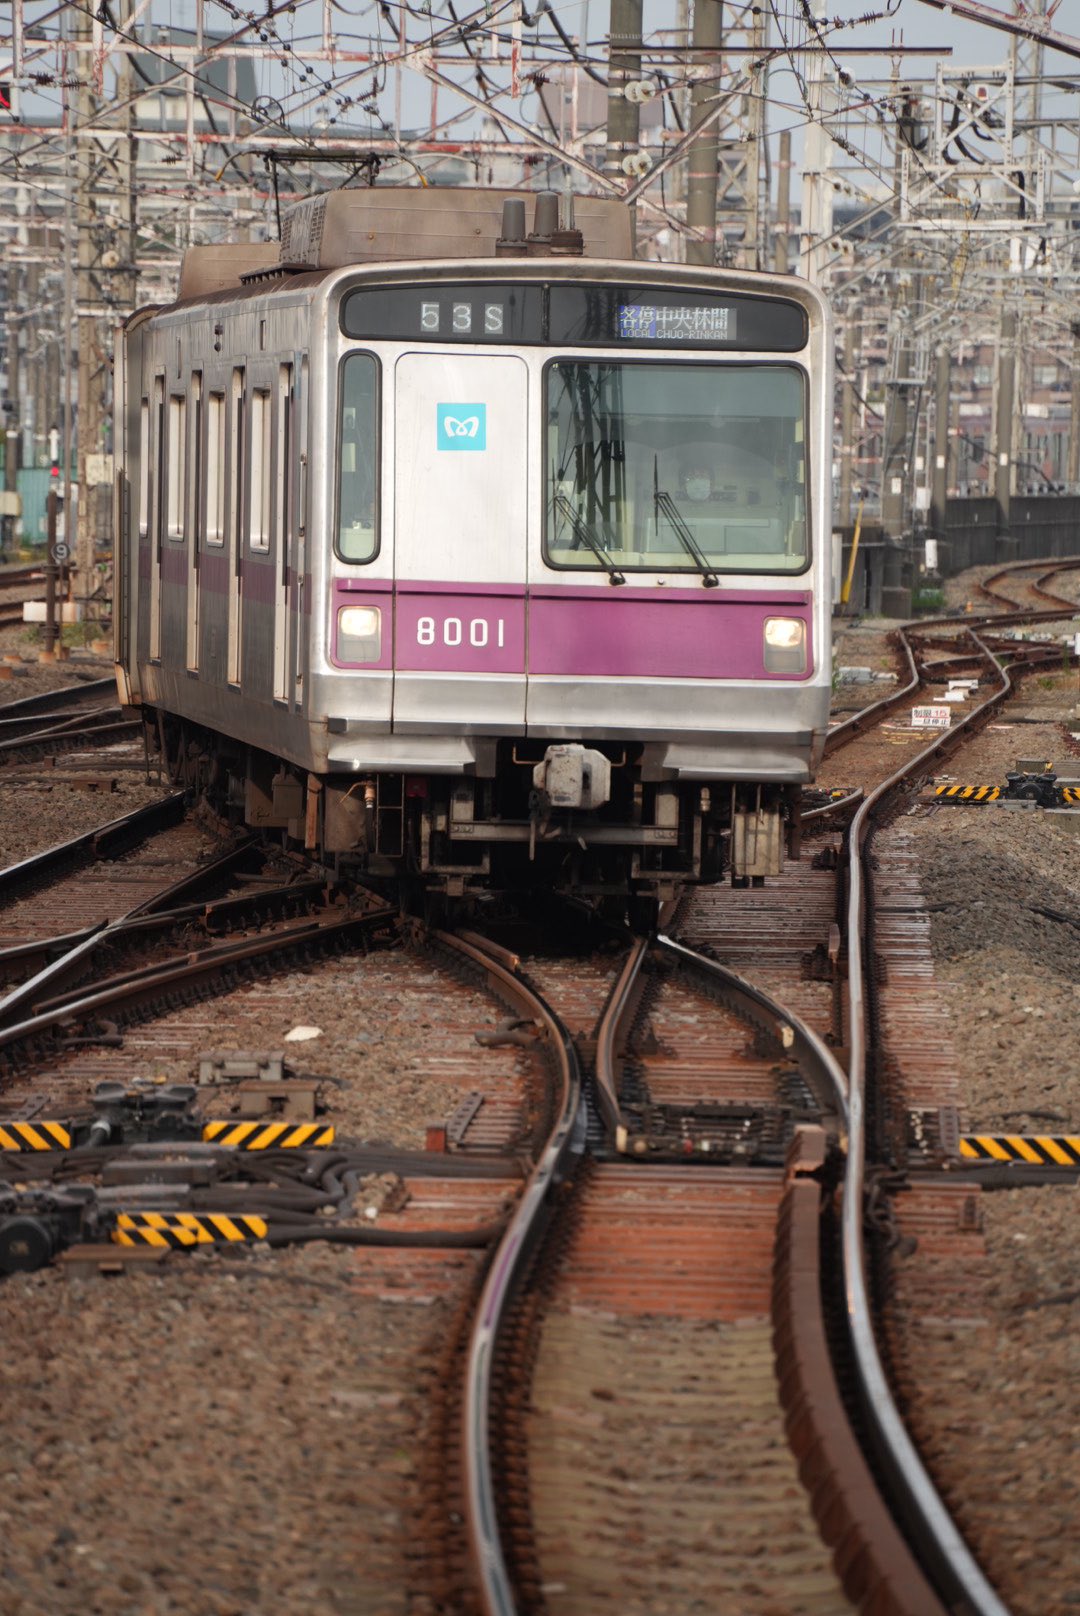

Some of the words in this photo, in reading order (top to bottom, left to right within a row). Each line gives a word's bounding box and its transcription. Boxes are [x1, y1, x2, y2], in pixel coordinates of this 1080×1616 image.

[621, 328, 655, 339] LOCAL
[656, 329, 728, 340] CHUO-RINKAN
[56, 544, 67, 559] 9
[417, 617, 504, 647] 8001
